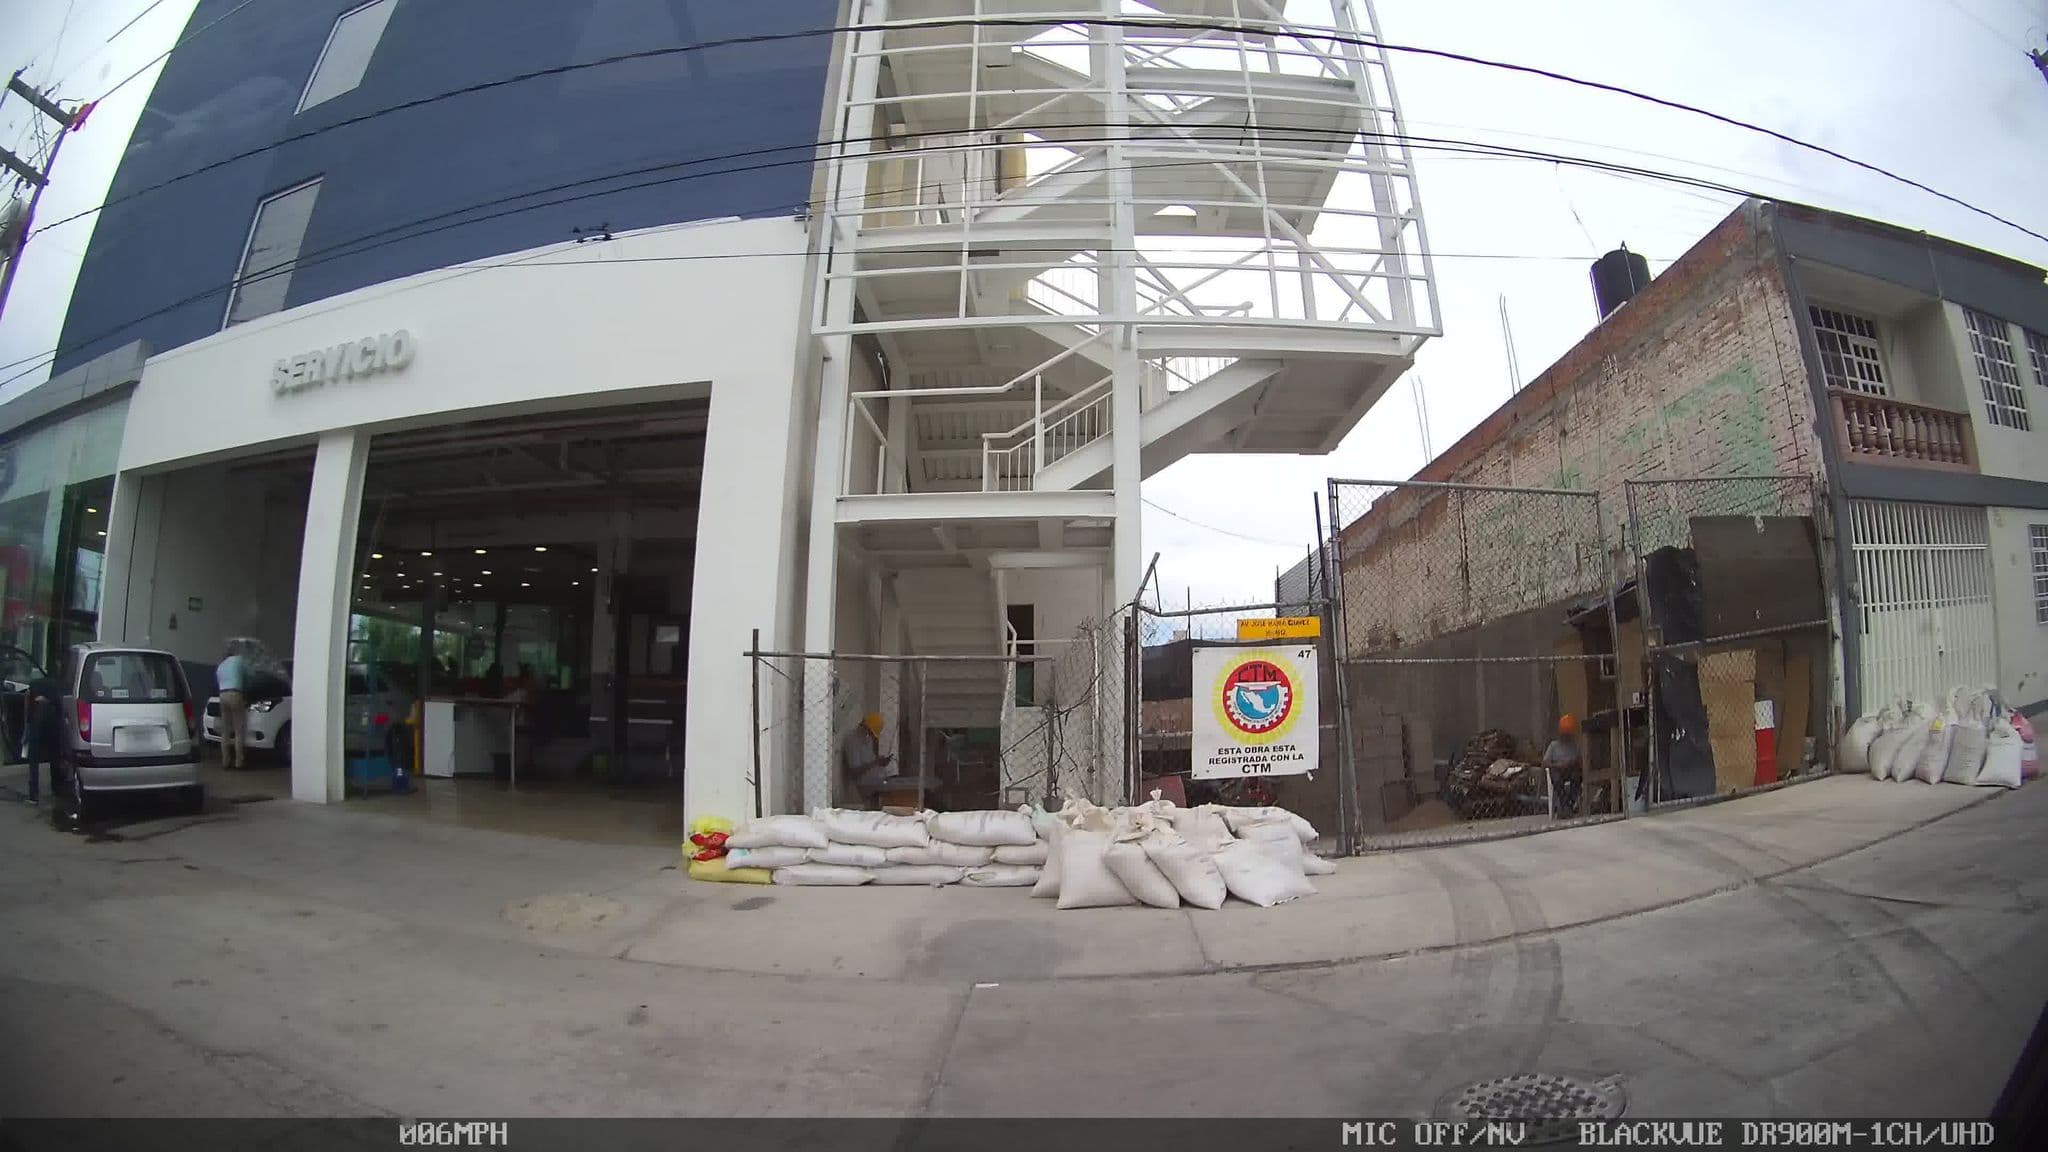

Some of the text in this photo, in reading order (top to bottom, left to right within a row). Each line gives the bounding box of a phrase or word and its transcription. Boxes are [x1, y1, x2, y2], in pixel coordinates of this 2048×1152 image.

[271, 329, 415, 394] SERVICIO
[1298, 650, 1311, 659] 47
[1238, 665, 1277, 682] CTM
[1218, 745, 1296, 755] ESTA OBRA ESTA
[1209, 756, 1268, 765] REGISTRADA
[1270, 754, 1290, 762] CON
[1242, 764, 1271, 774] CTM
